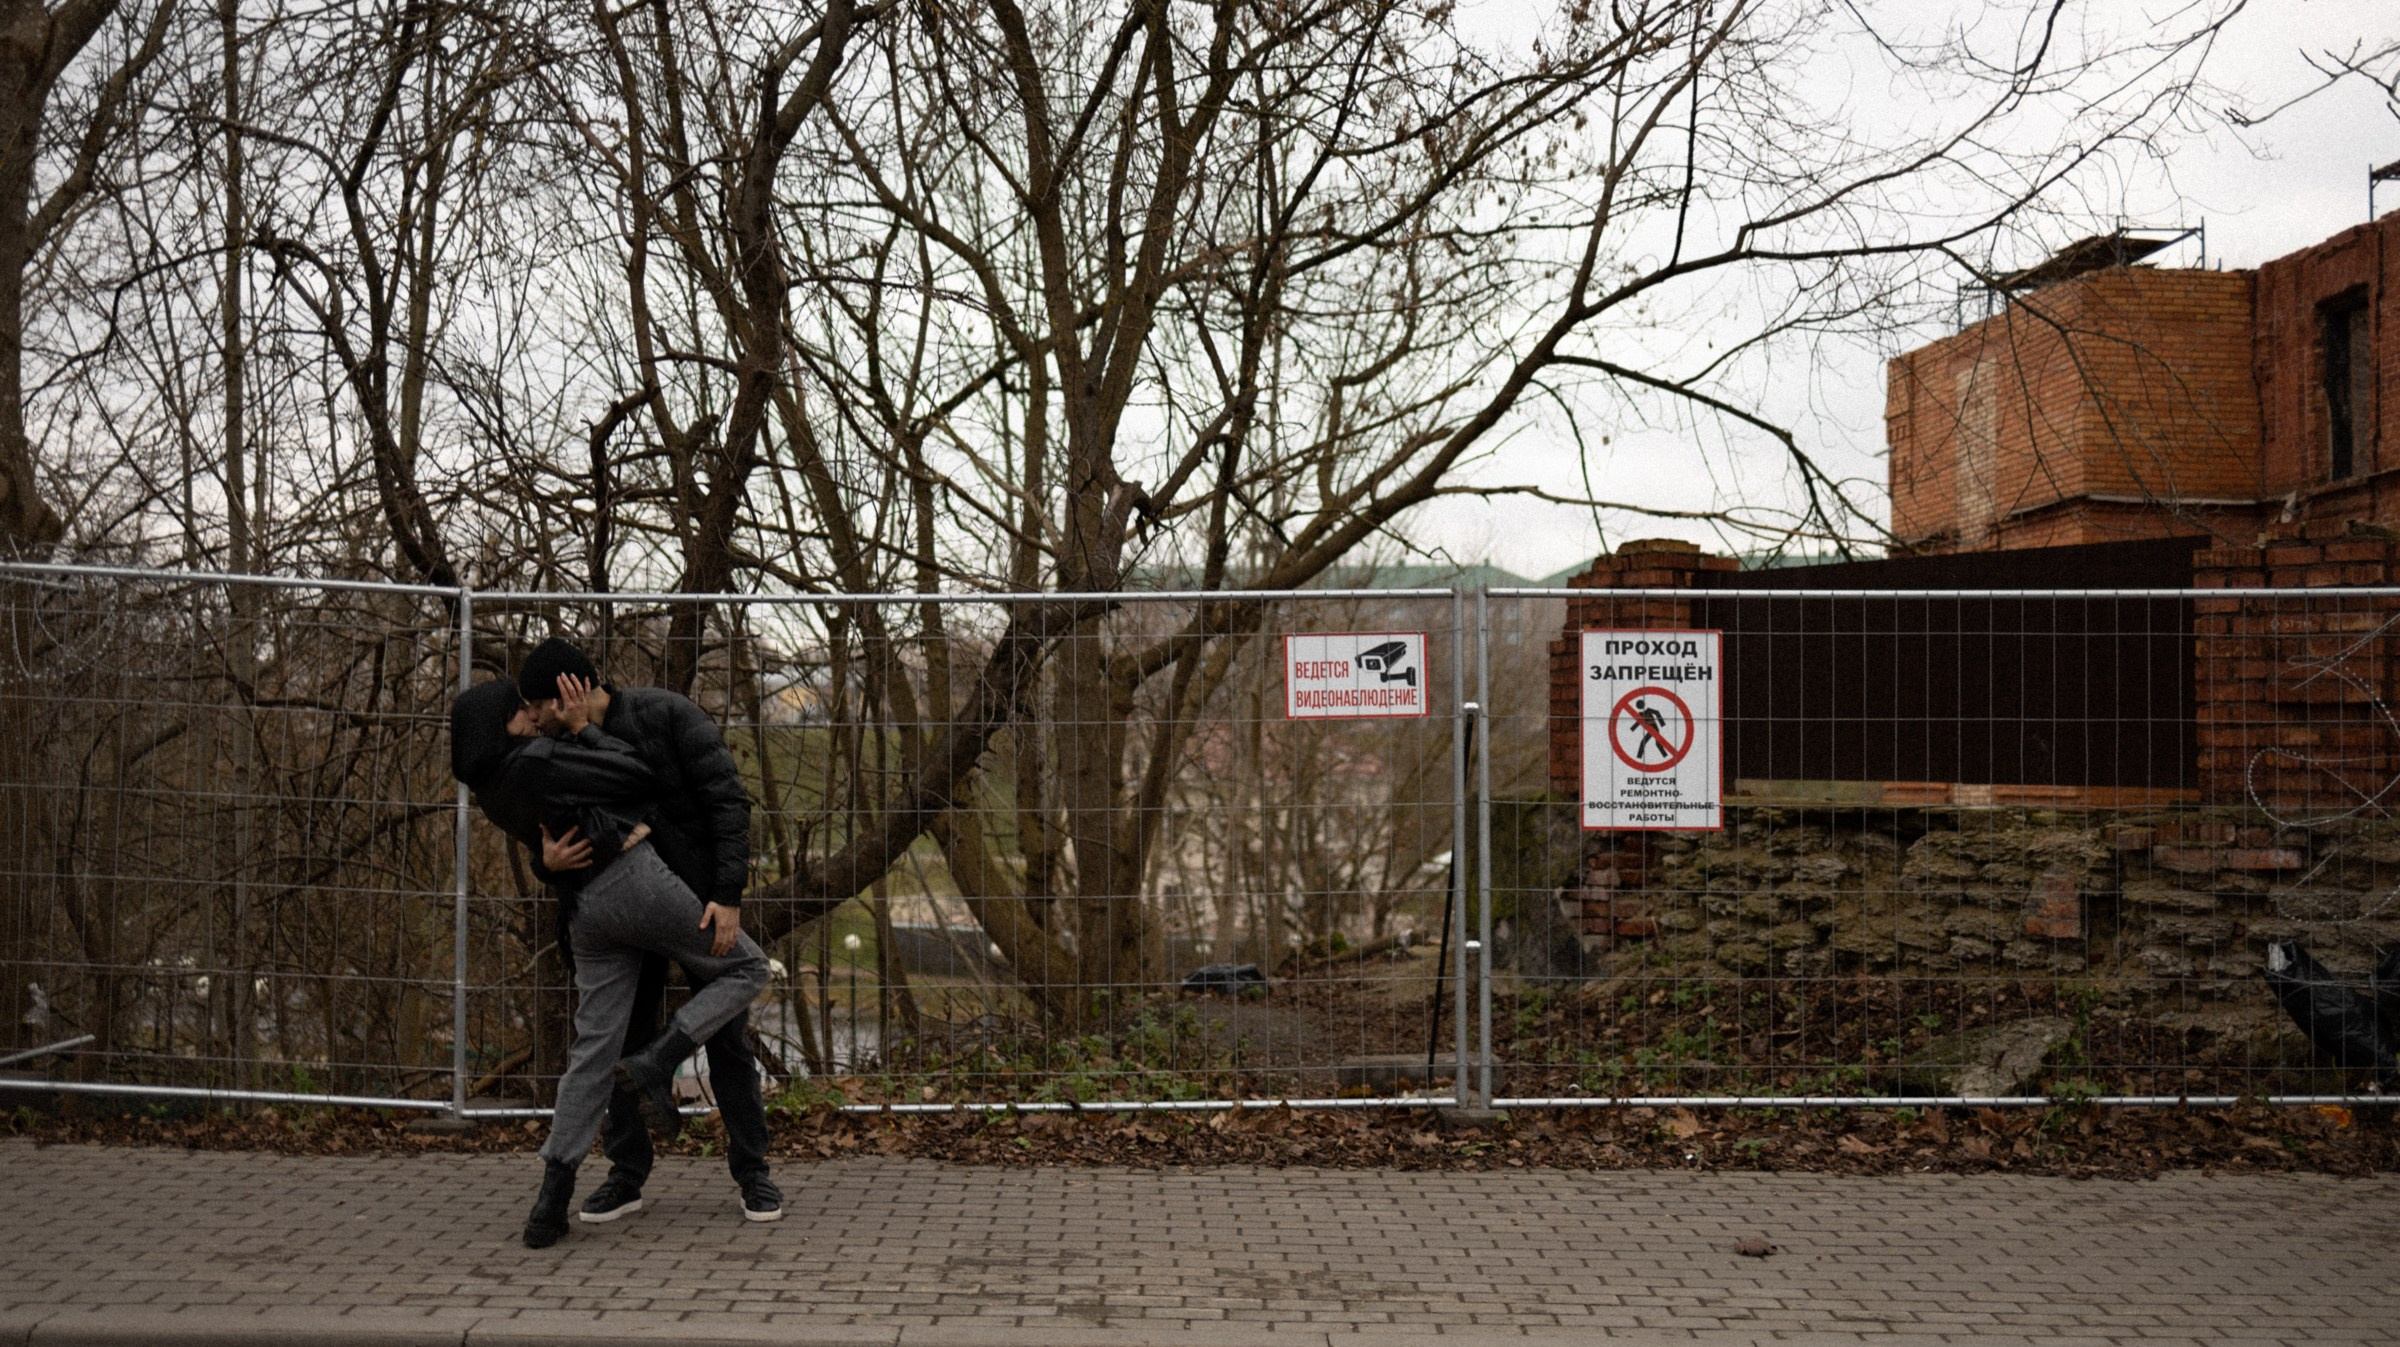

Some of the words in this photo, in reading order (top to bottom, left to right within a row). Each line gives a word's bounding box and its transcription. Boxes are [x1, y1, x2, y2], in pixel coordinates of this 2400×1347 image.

[1605, 640, 1698, 658] ПРОХОД
[1295, 661, 1349, 680] ВЕДЕТСЯ
[1590, 662, 1712, 683] ЗАПРЕЩЁН
[1296, 688, 1418, 709] ВИДЕОНАБЛЮДЕНИЕ
[1627, 777, 1676, 786] ВЕДУТСЯ
[1620, 789, 1683, 797] РЕМОНТНО-
[1588, 801, 1715, 810] ВОССТАНОВИТЕЛЬНЫЕ
[1628, 814, 1675, 822] РАБОТЫ
